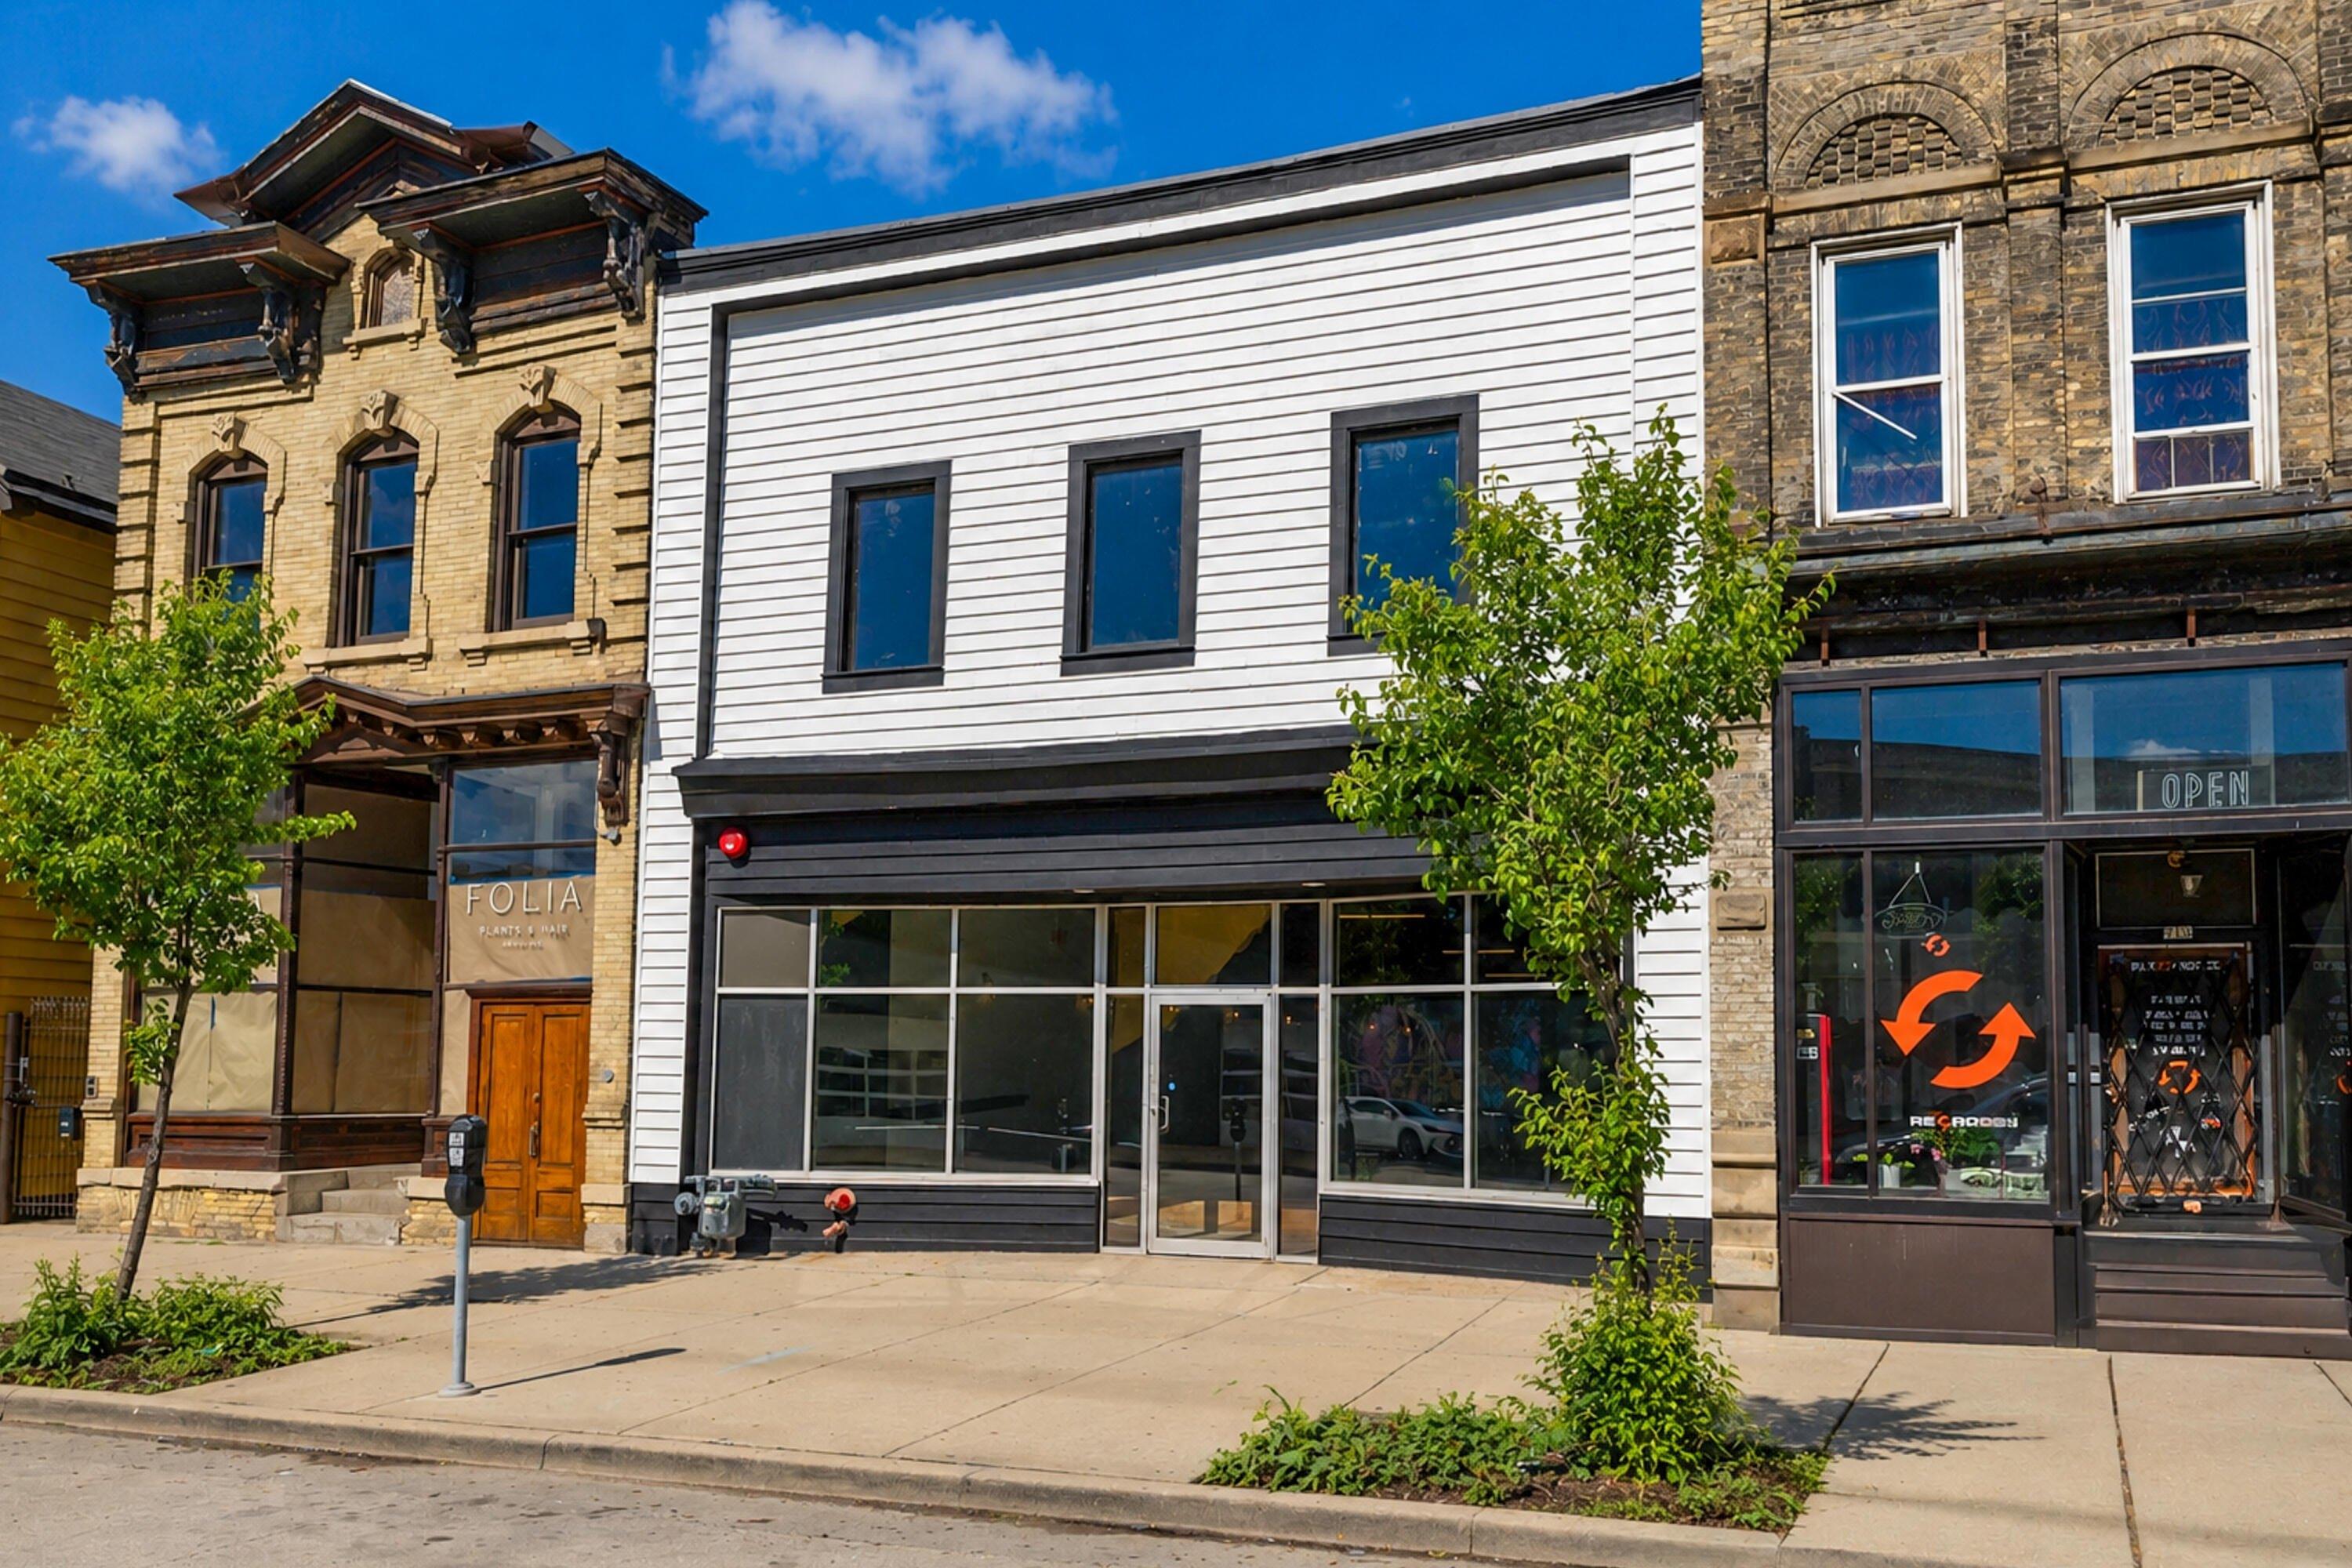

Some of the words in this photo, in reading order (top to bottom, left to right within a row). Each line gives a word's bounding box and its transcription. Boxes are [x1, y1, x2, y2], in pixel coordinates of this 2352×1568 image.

[2161, 771, 2249, 809] OPEN
[466, 880, 583, 915] FOLIA
[479, 925, 521, 936] PLANTS
